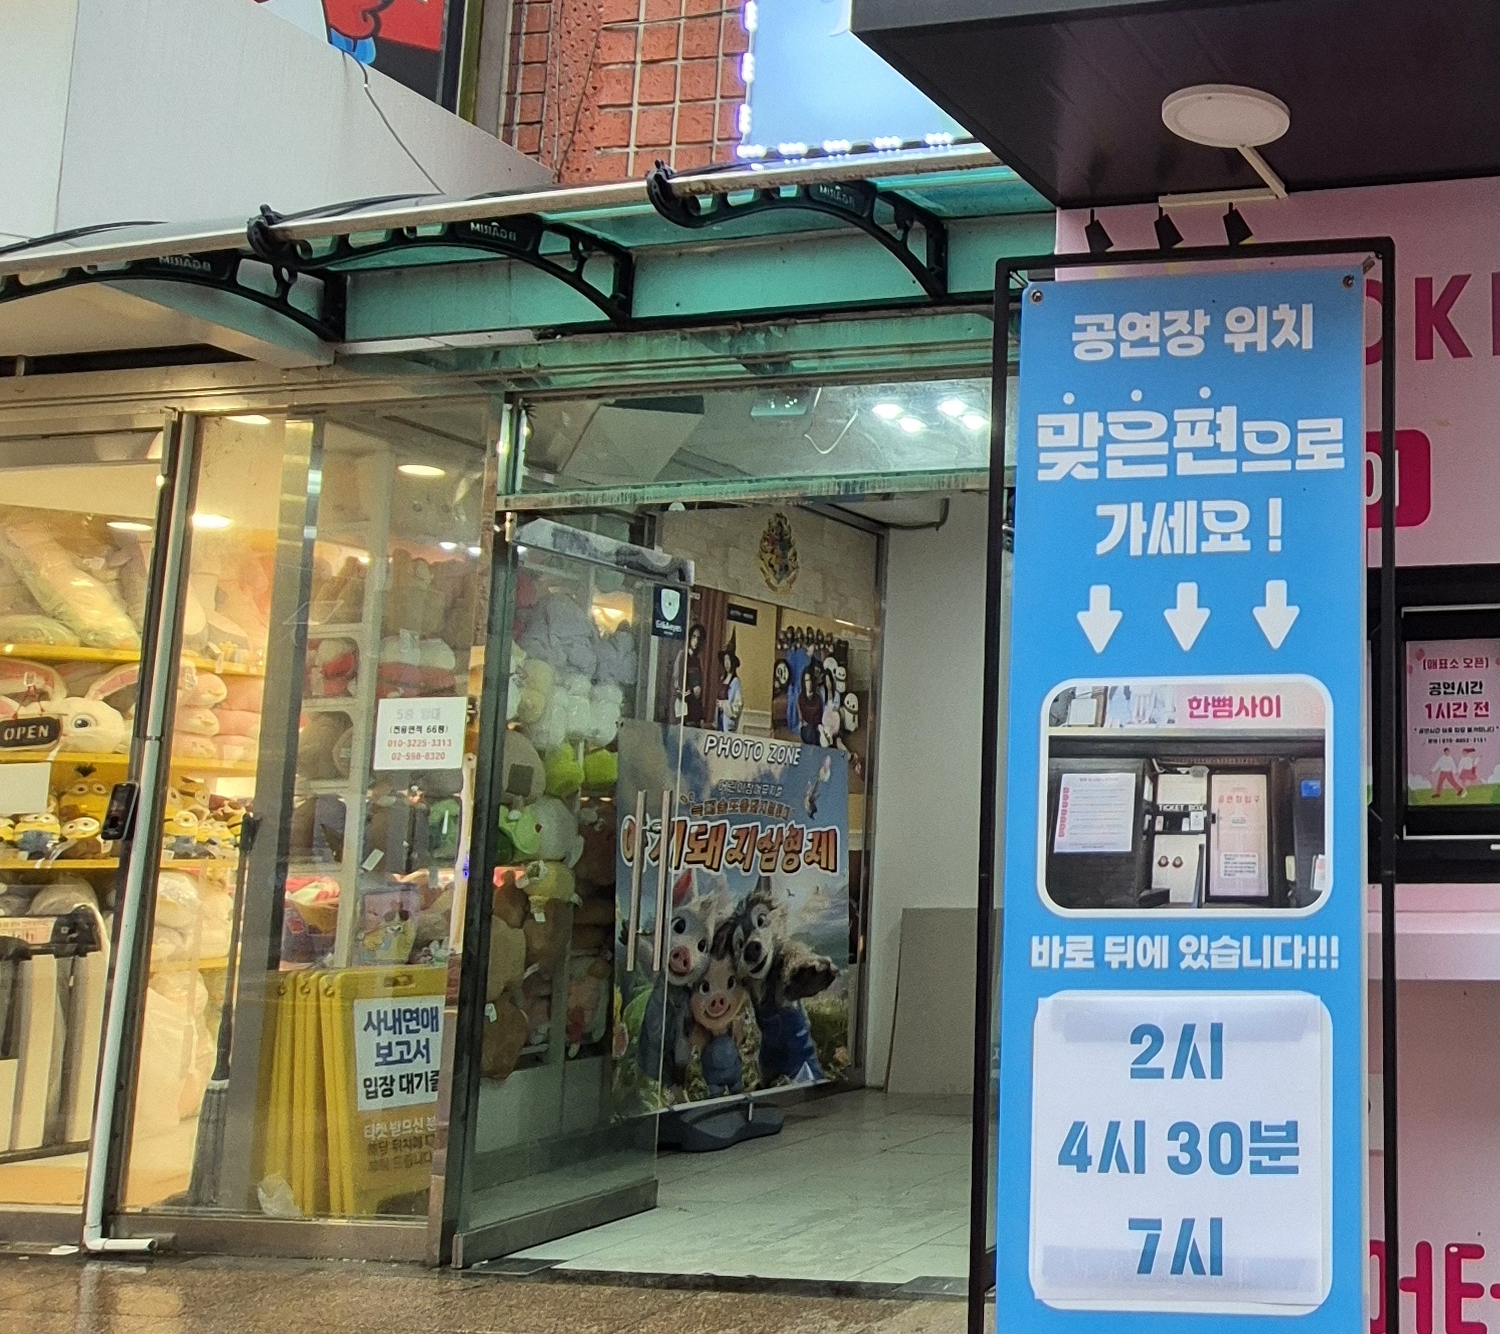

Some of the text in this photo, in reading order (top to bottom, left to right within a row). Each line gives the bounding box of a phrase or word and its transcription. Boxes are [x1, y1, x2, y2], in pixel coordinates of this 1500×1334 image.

[1071, 303, 1314, 362] 공연장 위치
[1037, 405, 1345, 482] 맞은편으로
[1429, 680, 1483, 696] 공연시간
[1424, 701, 1489, 719] 1시간 전
[3, 724, 50, 741] OPEN
[704, 734, 801, 766] PHOTO ZONE
[1030, 934, 1340, 970] 바로 뒤에 있습니다!!!
[363, 1005, 440, 1037] 사내연애
[374, 1038, 431, 1068] 보고서
[1128, 1021, 1224, 1081] 2시
[363, 1075, 395, 1100] 입장
[1057, 1119, 1300, 1176] 4시 30분
[1127, 1216, 1224, 1278] 7시
